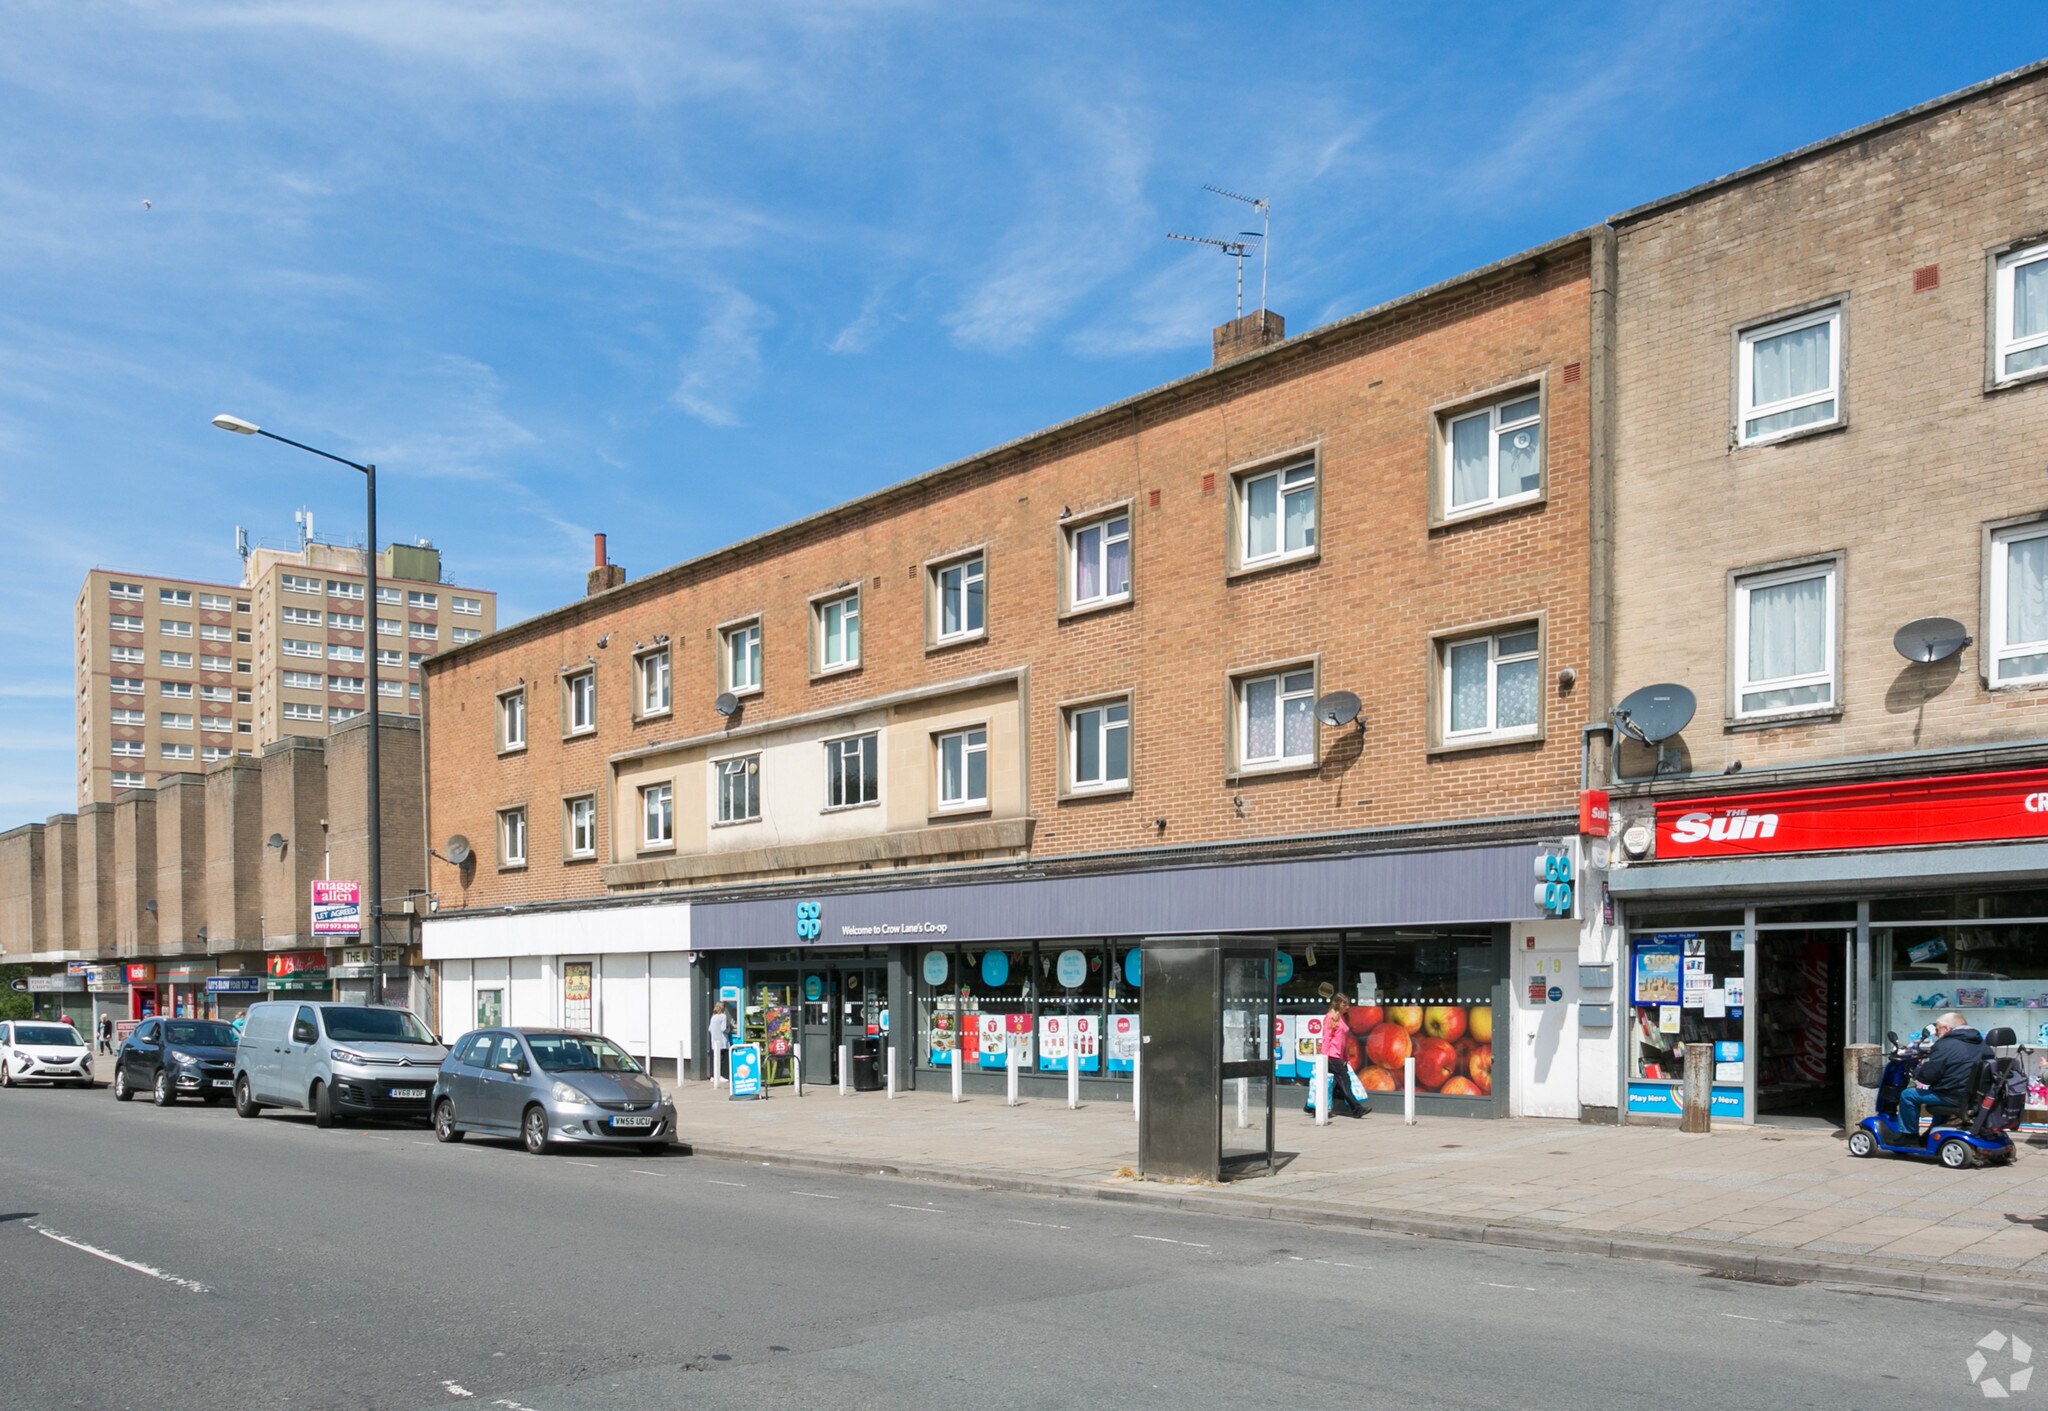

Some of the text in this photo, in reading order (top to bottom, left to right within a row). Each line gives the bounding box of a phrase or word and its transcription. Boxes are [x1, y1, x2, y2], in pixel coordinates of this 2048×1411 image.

[1592, 807, 1608, 819] Sun
[1725, 809, 1749, 817] THE
[1671, 812, 1779, 843] Sun
[317, 882, 358, 892] maggs
[321, 890, 352, 901] allen
[316, 908, 357, 920] LET AGREED
[842, 922, 948, 936] Welcome to Crow Lane's Co-op
[345, 950, 397, 962] THE SORE
[775, 1041, 786, 1051] £5
[393, 1089, 411, 1097] AV68
[1629, 1094, 1647, 1103] Play
[1718, 1096, 1739, 1104] Here
[615, 1117, 651, 1126] VN55 UCU
